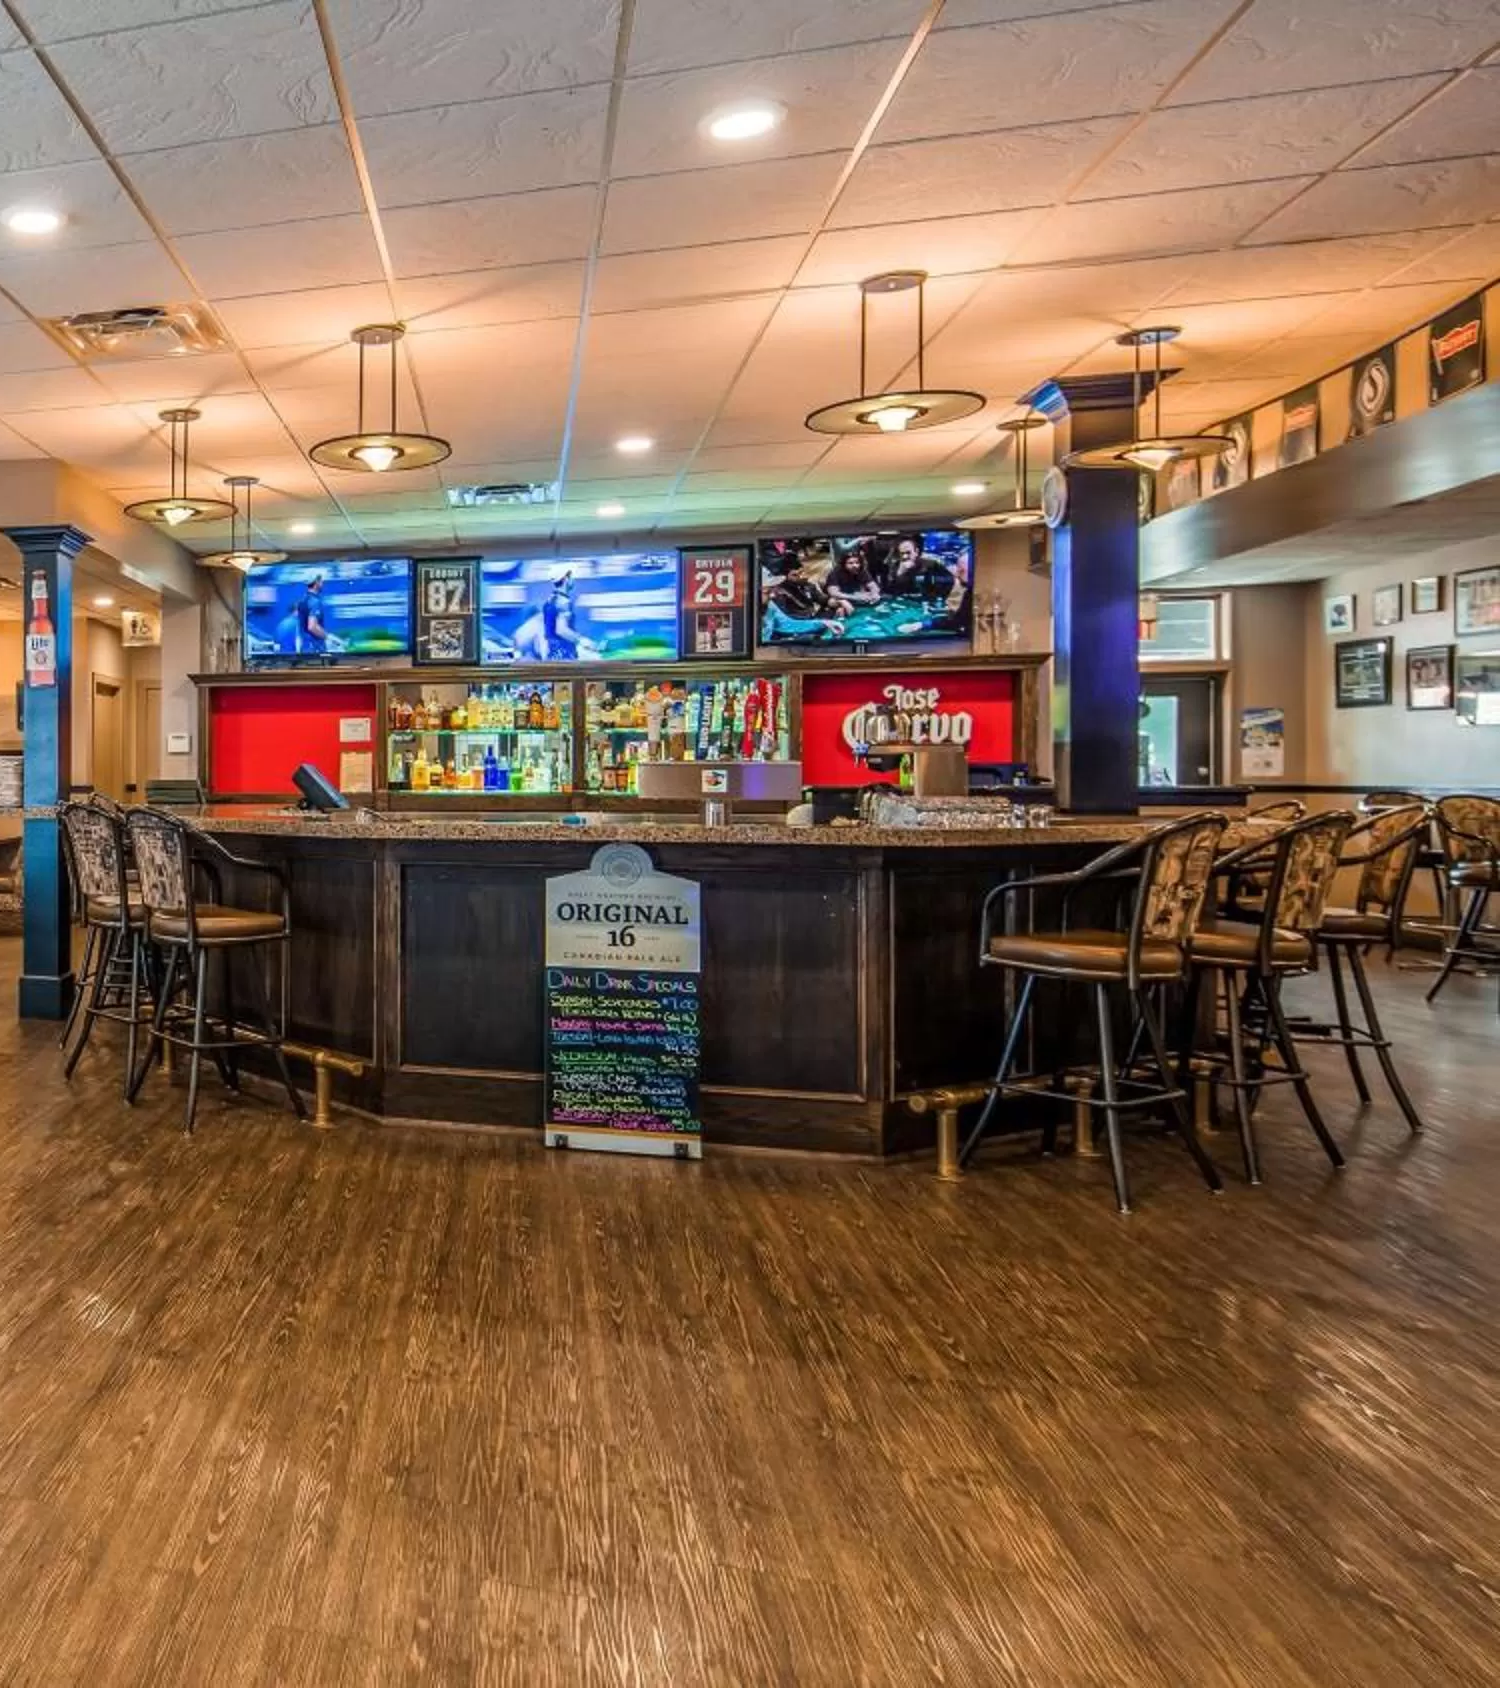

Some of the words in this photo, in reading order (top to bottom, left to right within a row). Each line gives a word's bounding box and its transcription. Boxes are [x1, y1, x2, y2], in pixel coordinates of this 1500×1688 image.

[427, 579, 466, 613] 87
[694, 569, 735, 603] 29
[701, 696, 713, 724] LIGHT
[883, 684, 940, 711] Jose
[699, 727, 709, 749] BUD
[557, 902, 689, 925] ORIGINAL
[607, 925, 636, 947] 16
[563, 951, 623, 961] CANADIAN
[627, 954, 654, 963] PALE
[660, 955, 681, 963] ALE
